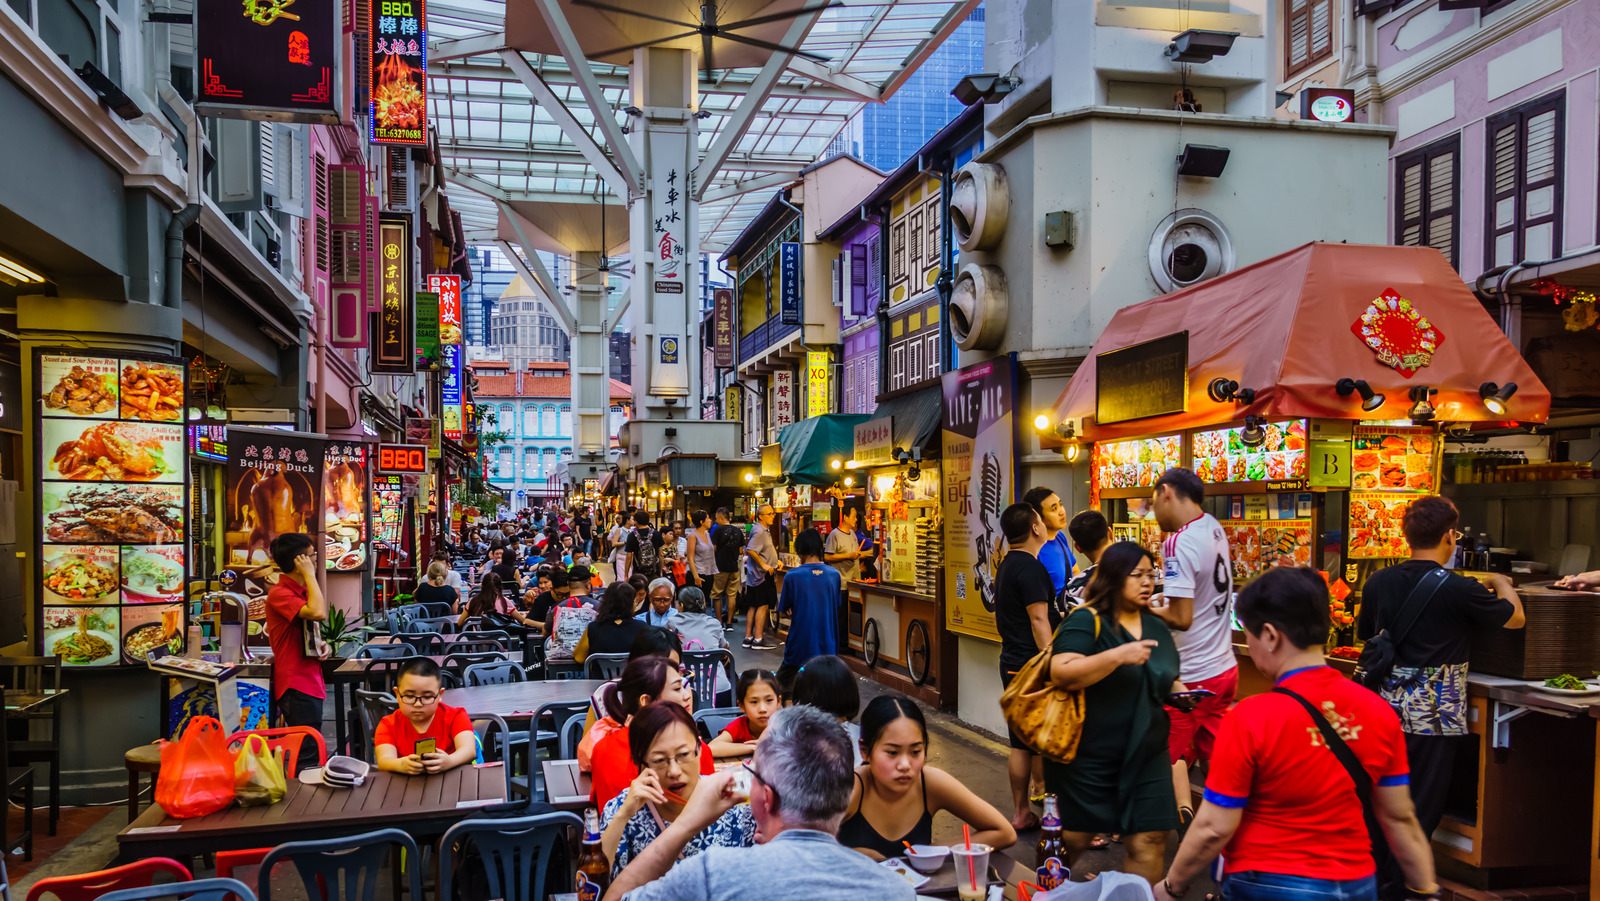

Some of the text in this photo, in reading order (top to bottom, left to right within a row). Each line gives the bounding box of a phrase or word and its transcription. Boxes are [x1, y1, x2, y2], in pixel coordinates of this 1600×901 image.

[382, 2, 413, 16] BBQ
[379, 16, 418, 35] 棒棒
[375, 128, 421, 139] TEL:63270688
[665, 169, 681, 223] 牛車水
[1145, 352, 1180, 373] STREET
[811, 368, 826, 380] XO
[777, 372, 791, 426] 新聲詩社
[325, 445, 362, 456] 京烤鸭
[381, 449, 424, 469] BBQ
[240, 458, 315, 473] Beijing Duck
[1323, 453, 1338, 475] B
[1213, 553, 1230, 614] 9
